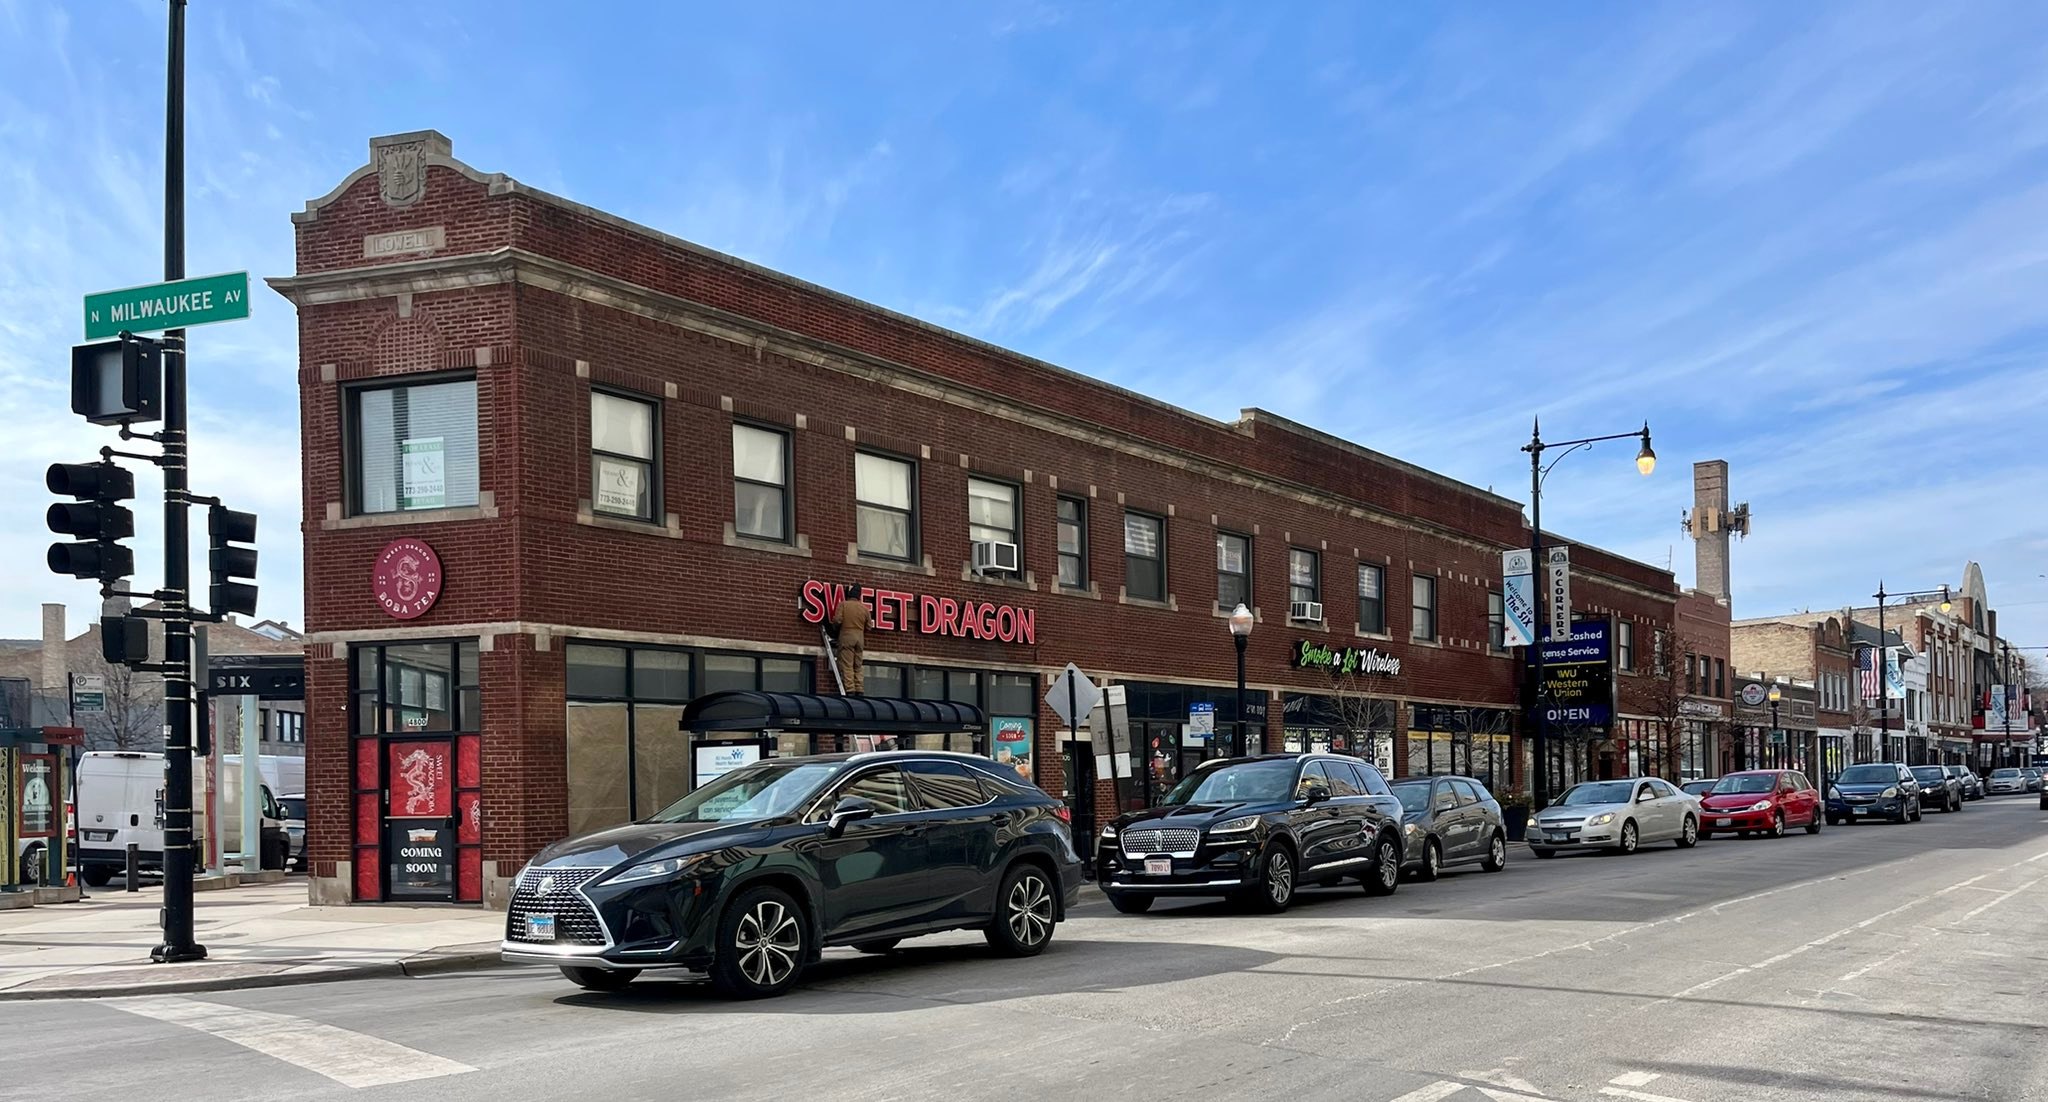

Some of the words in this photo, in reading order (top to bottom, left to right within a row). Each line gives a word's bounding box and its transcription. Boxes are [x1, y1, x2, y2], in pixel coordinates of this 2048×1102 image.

[374, 232, 435, 253] LOWELL
[91, 310, 99, 323] N
[111, 291, 213, 322] MILWAUKEE
[224, 289, 241, 303] AV
[383, 545, 402, 563] SWEET
[405, 544, 430, 561] DRAGON
[379, 591, 408, 614] BOBA
[414, 590, 435, 610] TEA
[1505, 580, 1528, 608] Welcome
[803, 580, 914, 632] SWEET
[920, 594, 1035, 645] DRAGON
[1505, 594, 1520, 613] The
[1517, 611, 1533, 628] SIX
[1555, 578, 1565, 637] CORNERS
[1300, 640, 1332, 667] Smoke
[1333, 652, 1341, 666] a
[1342, 647, 1358, 673] Lot
[1360, 648, 1400, 675] Wireless
[1542, 649, 1566, 658] cense
[1567, 646, 1600, 656] Service
[216, 675, 251, 688] SIX
[1547, 679, 1588, 689] Western
[1553, 688, 1582, 697] Union
[1547, 708, 1590, 720] OPEN
[1000, 720, 1023, 731] Coming
[22, 763, 51, 774] Welcome
[400, 847, 443, 858] COMING
[405, 863, 438, 874] SOON!
